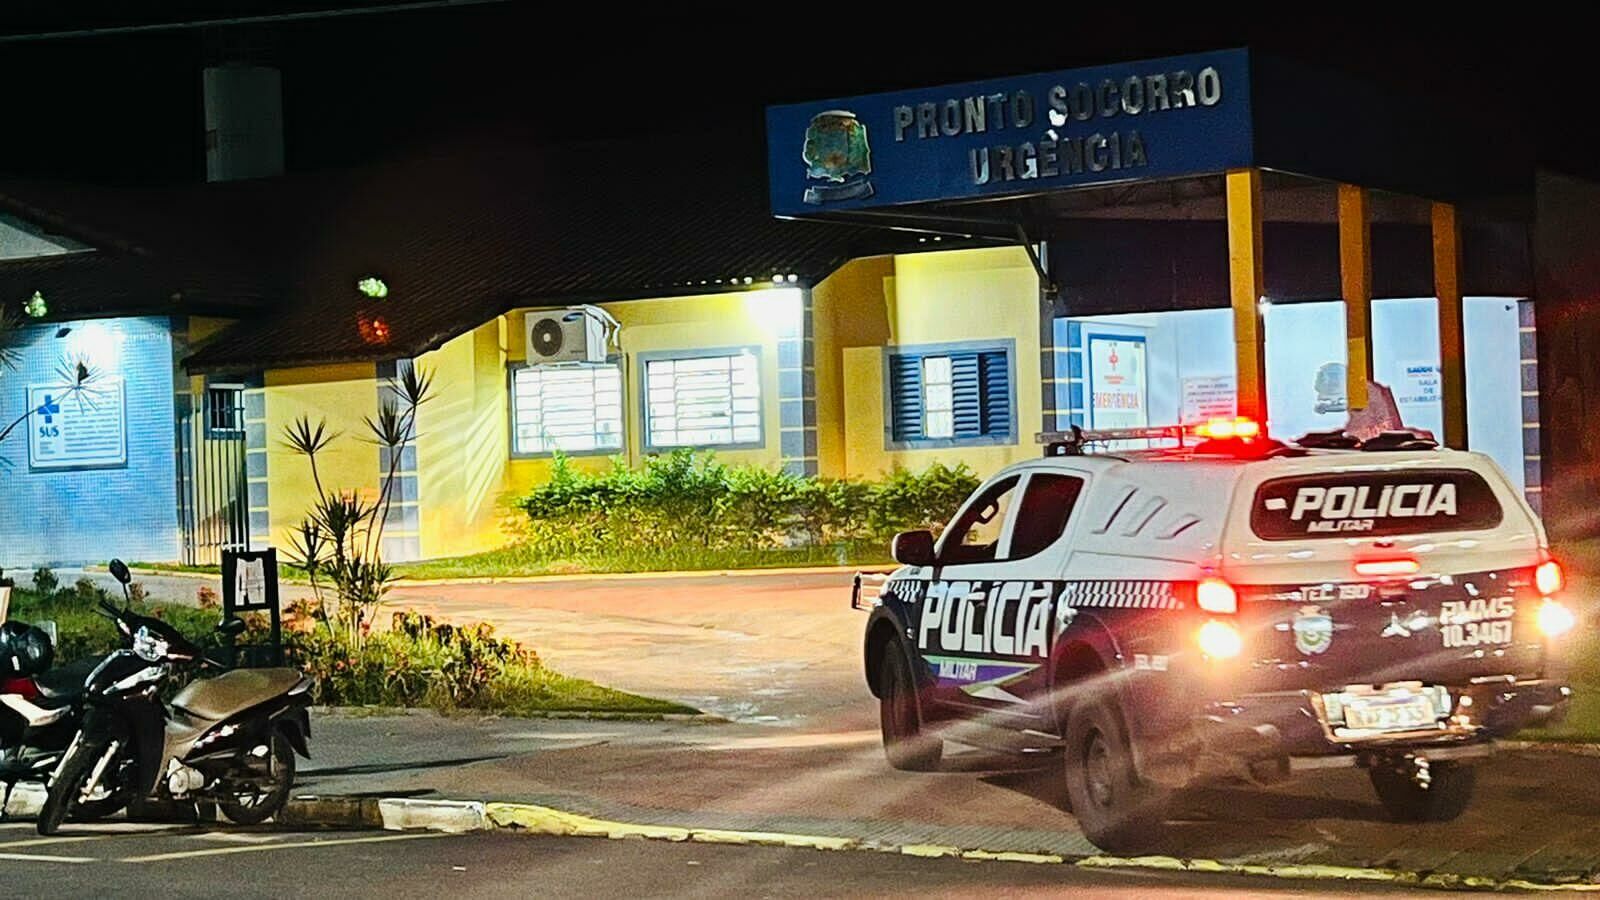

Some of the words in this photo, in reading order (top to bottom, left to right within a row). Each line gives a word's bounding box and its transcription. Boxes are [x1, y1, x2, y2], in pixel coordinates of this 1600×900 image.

[893, 89, 1034, 141] PRONTO
[1048, 67, 1221, 126] SOCORRO
[970, 129, 1147, 184] URGÊNCIA
[39, 426, 59, 438] SUS
[1306, 519, 1374, 533] MILITAR
[938, 660, 978, 681] MILITAR
